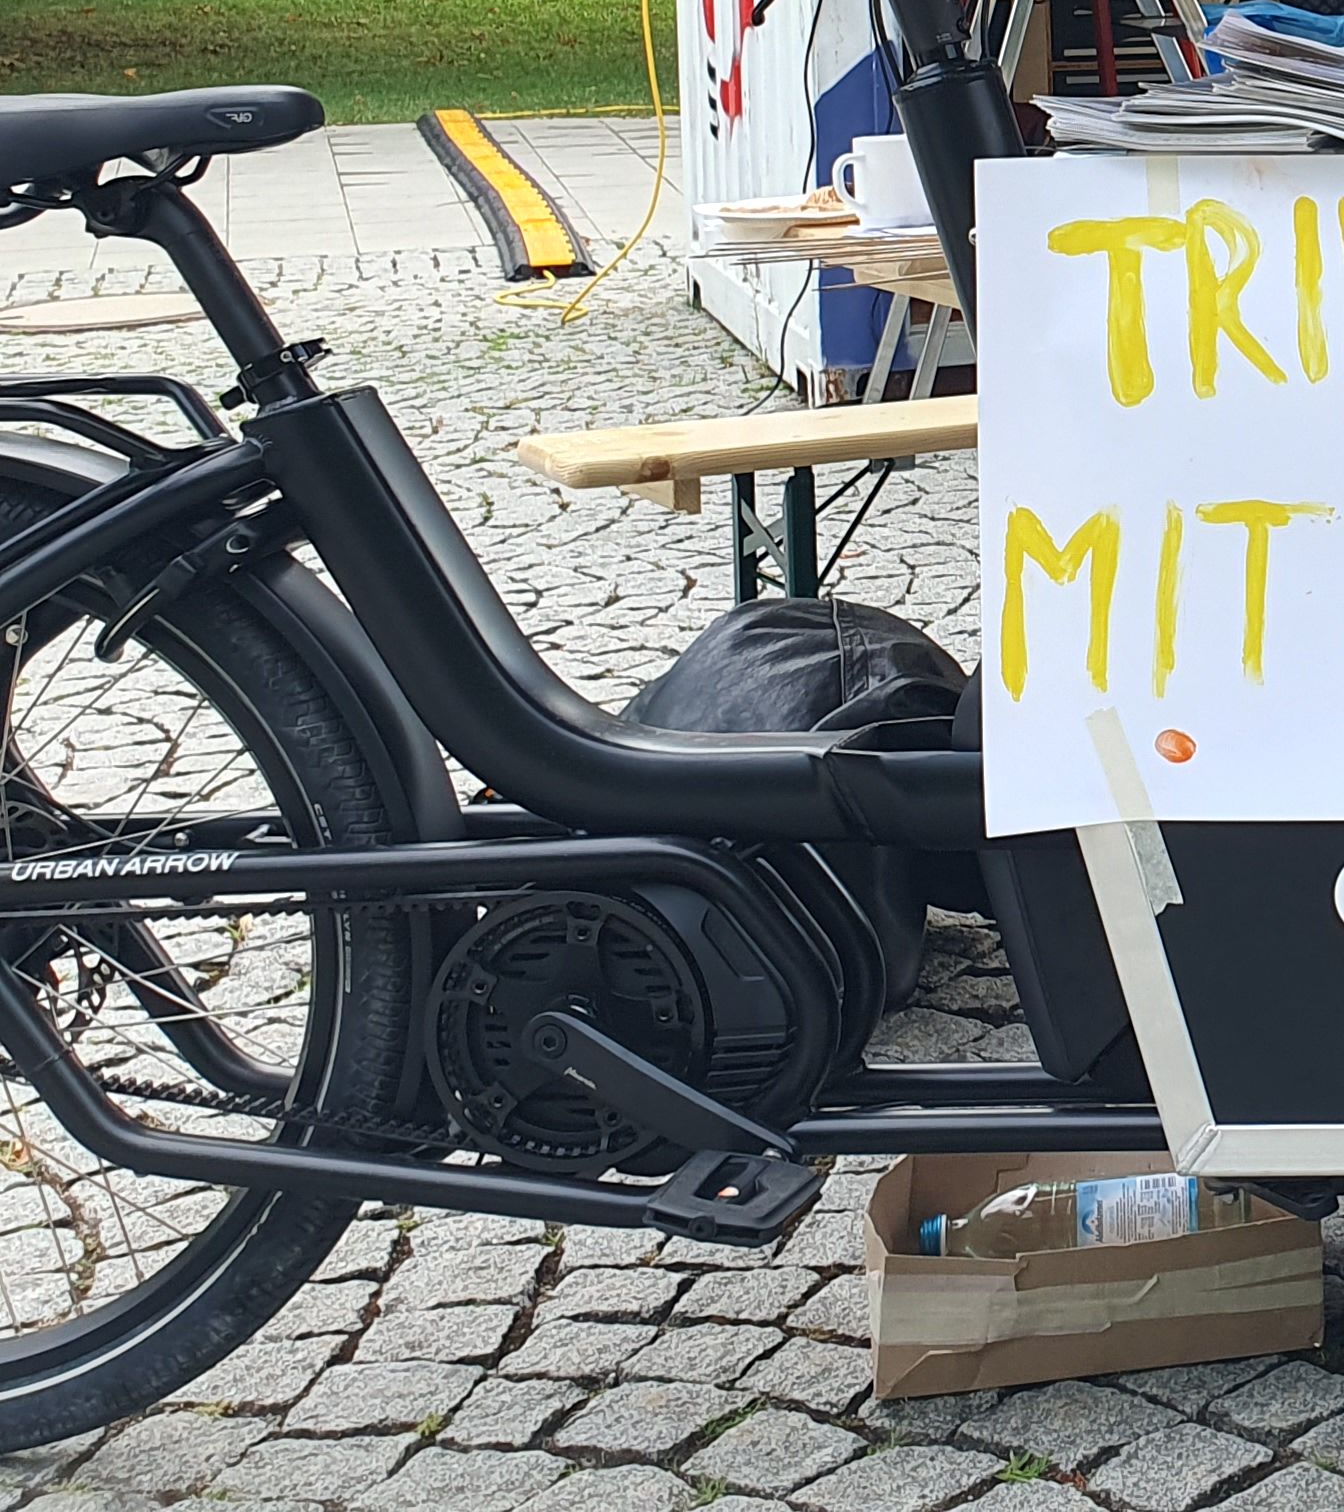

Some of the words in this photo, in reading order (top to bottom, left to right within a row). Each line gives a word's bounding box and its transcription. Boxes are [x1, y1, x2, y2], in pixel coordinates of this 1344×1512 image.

[998, 496, 1342, 702] MIT
[10, 857, 120, 881] URBAN
[120, 852, 240, 876] ARROW
